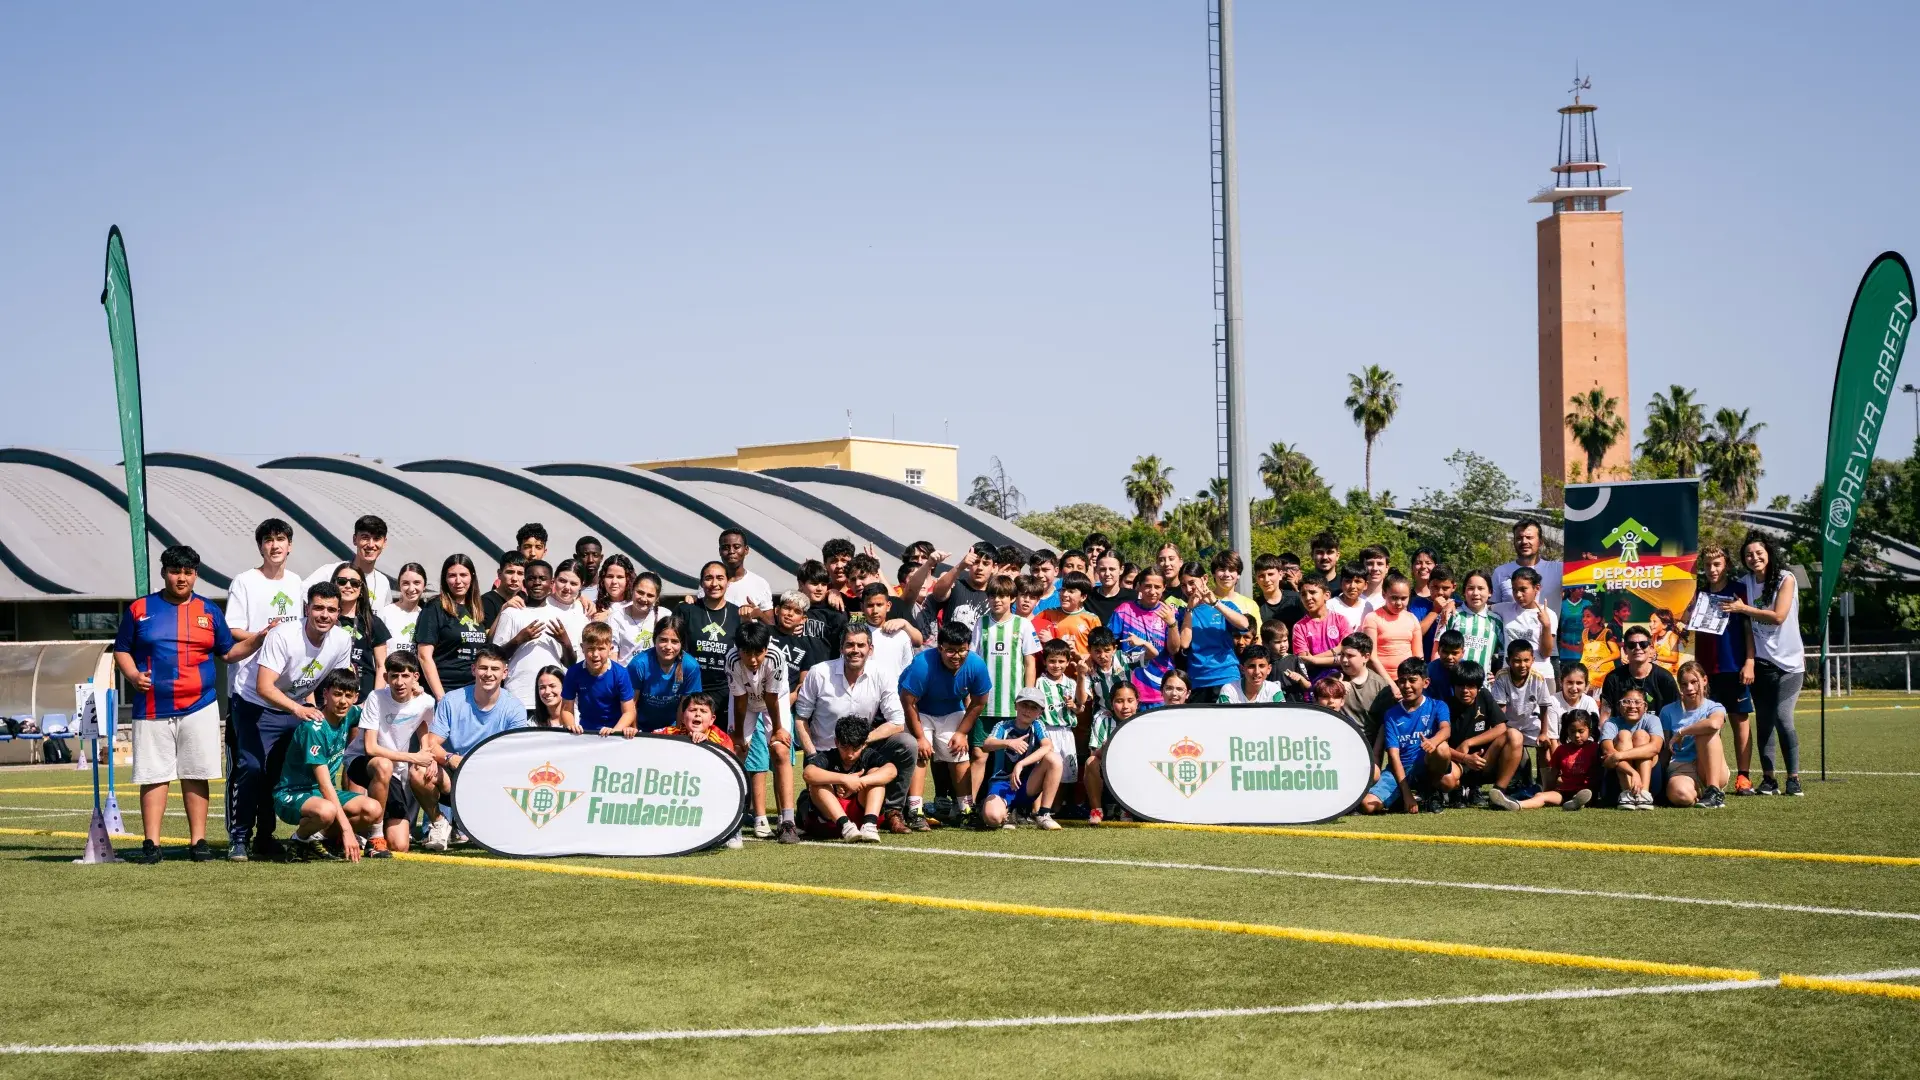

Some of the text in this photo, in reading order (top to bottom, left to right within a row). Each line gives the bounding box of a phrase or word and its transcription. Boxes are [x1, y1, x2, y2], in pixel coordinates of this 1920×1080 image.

[1873, 290, 1912, 396] GREEN
[1593, 565, 1664, 580] DEPORTE
[1606, 578, 1662, 590] REFUGIO
[461, 631, 487, 639] DEPORTE
[696, 640, 728, 650] DEPORTE
[702, 646, 727, 655] REFUGIO
[1229, 735, 1331, 762] Real Betis
[591, 765, 701, 797] Real Betis
[1231, 763, 1339, 791] Fundación
[587, 797, 704, 827] Fundación
